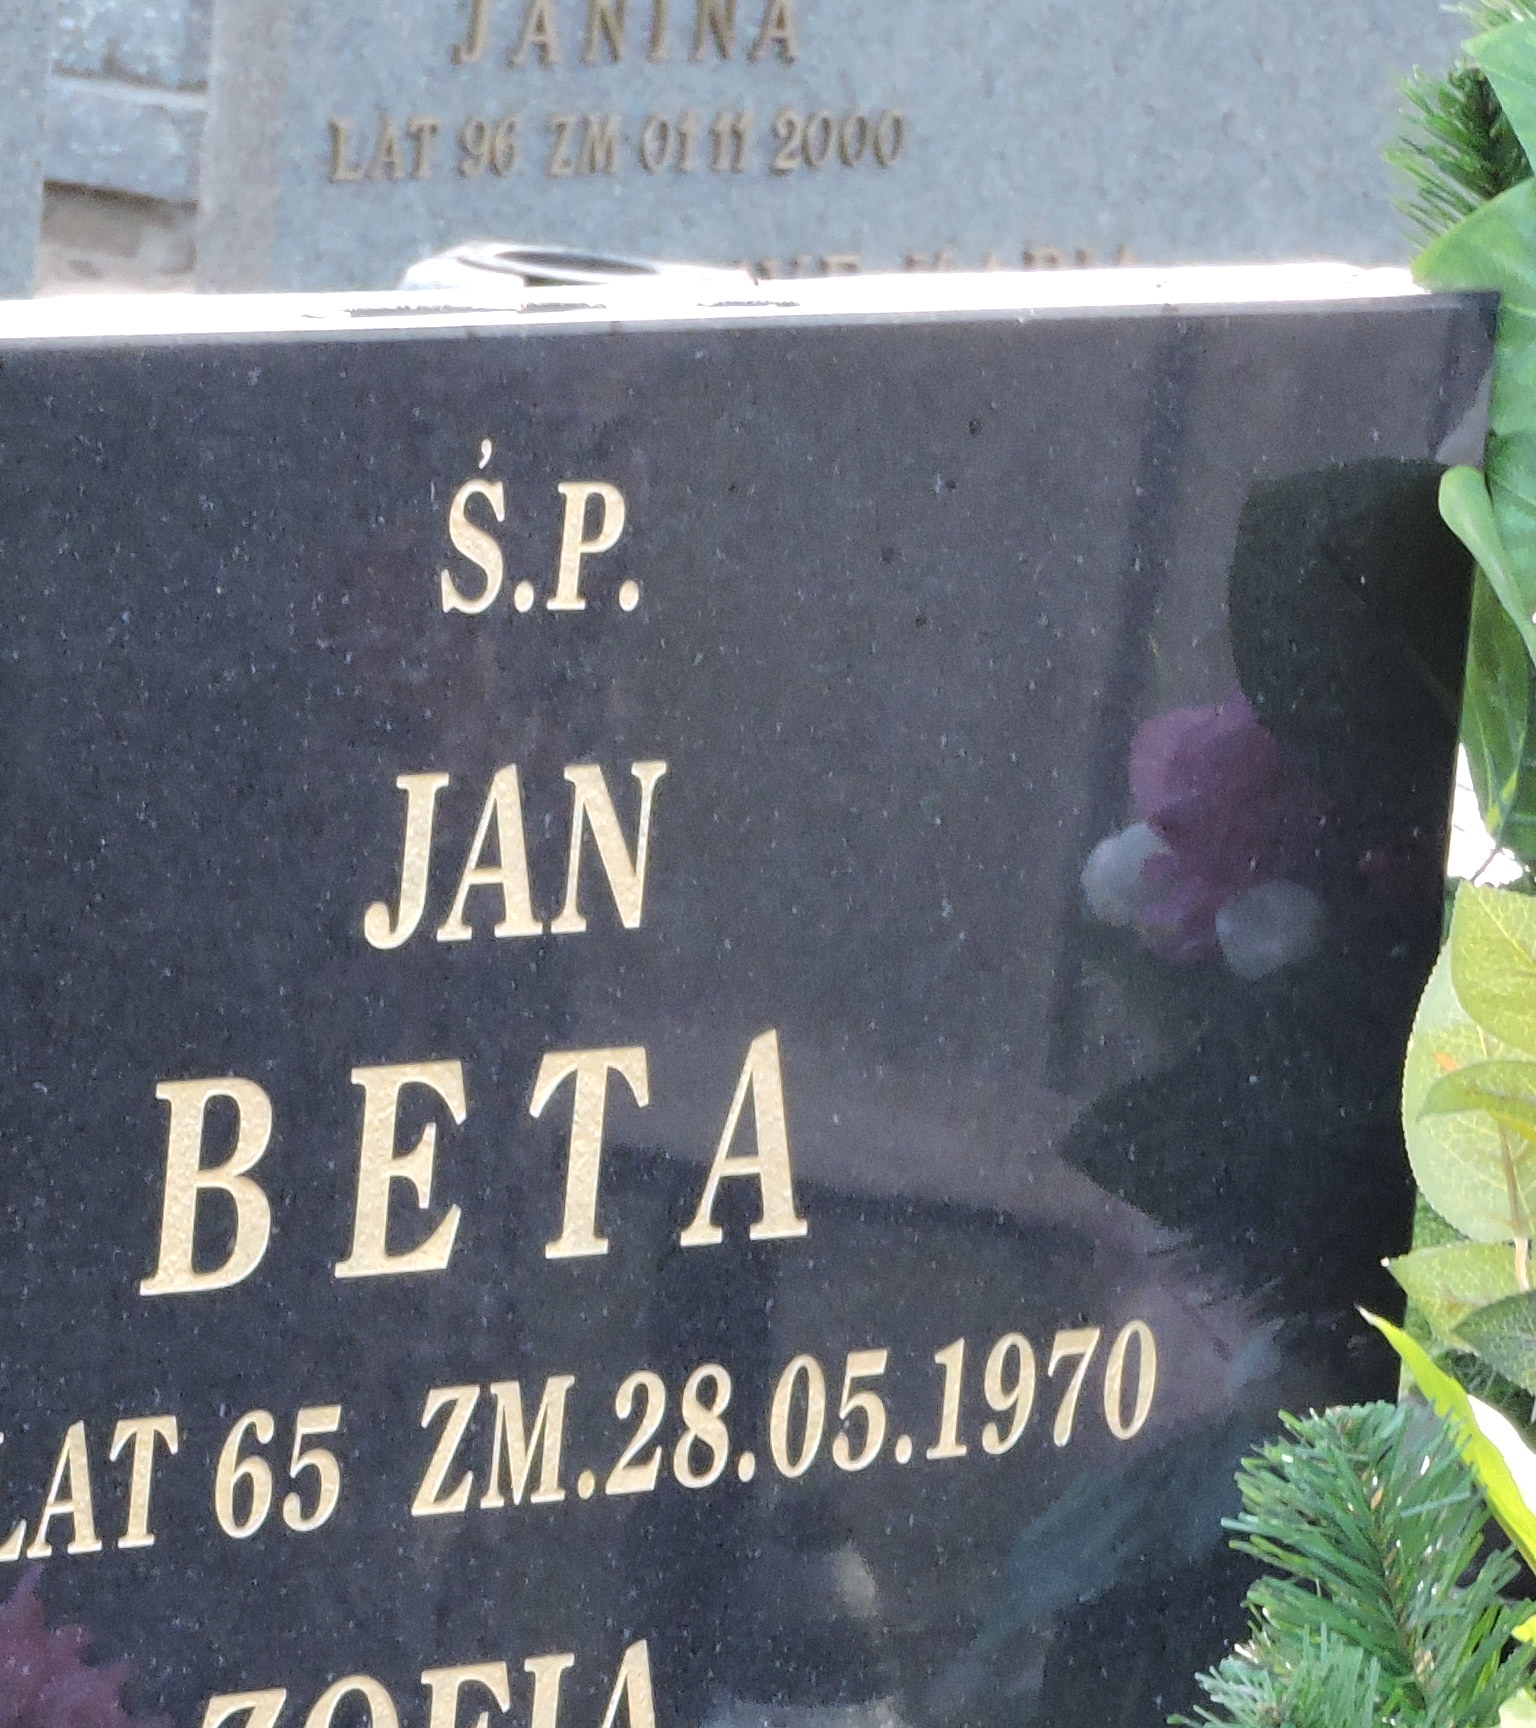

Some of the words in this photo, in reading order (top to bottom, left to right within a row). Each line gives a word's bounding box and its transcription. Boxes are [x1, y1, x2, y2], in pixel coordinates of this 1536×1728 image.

[329, 112, 440, 183] LAT
[460, 112, 518, 178] 96
[546, 110, 622, 178] ZM
[768, 106, 906, 176] 2000
[441, 436, 641, 614] Ś.P.
[363, 759, 668, 950] JAN
[138, 1026, 810, 1298] BETA
[212, 1402, 343, 1538] 65
[409, 1319, 1161, 1520] ZM.28.05.1970
